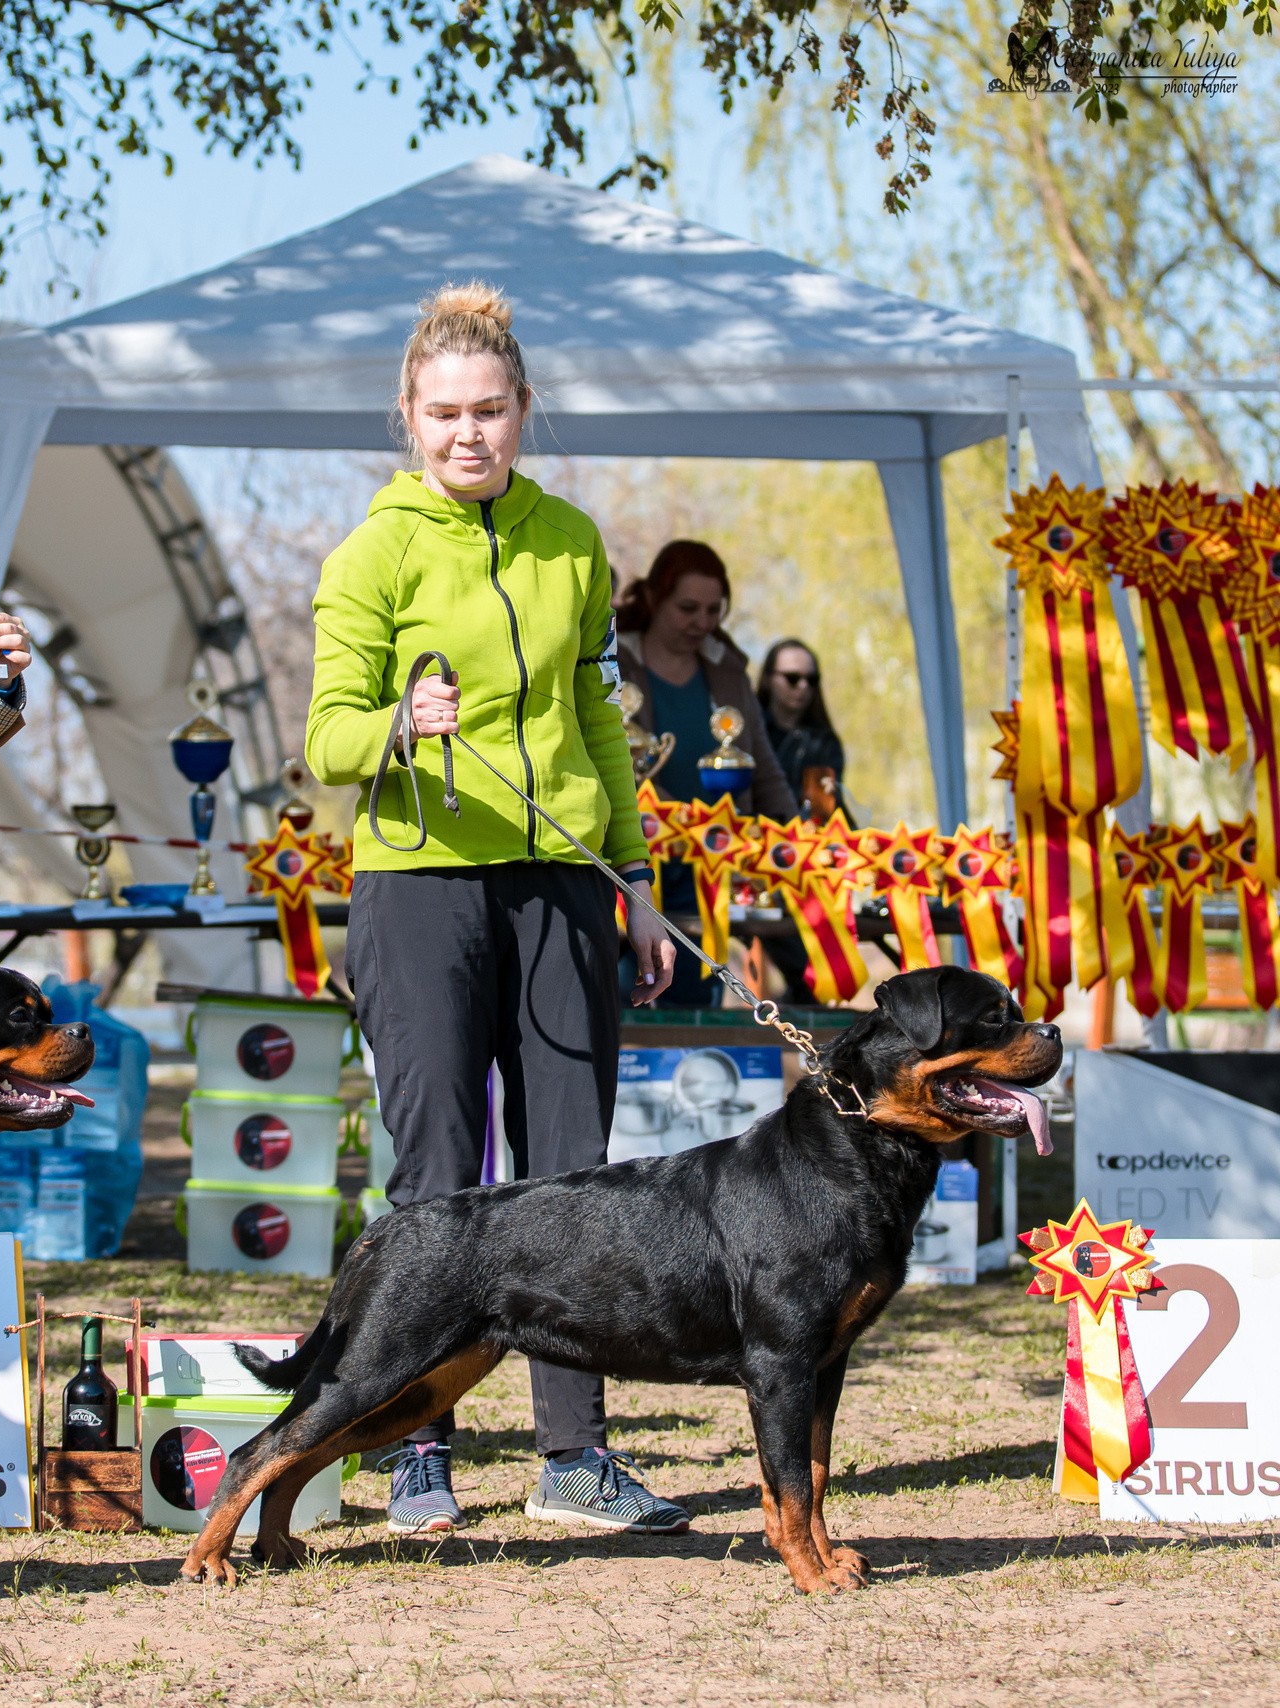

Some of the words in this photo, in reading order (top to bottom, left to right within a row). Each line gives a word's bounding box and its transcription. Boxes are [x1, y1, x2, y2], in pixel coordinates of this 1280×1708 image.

[1097, 1187, 1166, 1221] LED
[1176, 1187, 1223, 1221] TV
[1136, 1263, 1248, 1429] 2
[1125, 1460, 1280, 1497] SIRIUS
